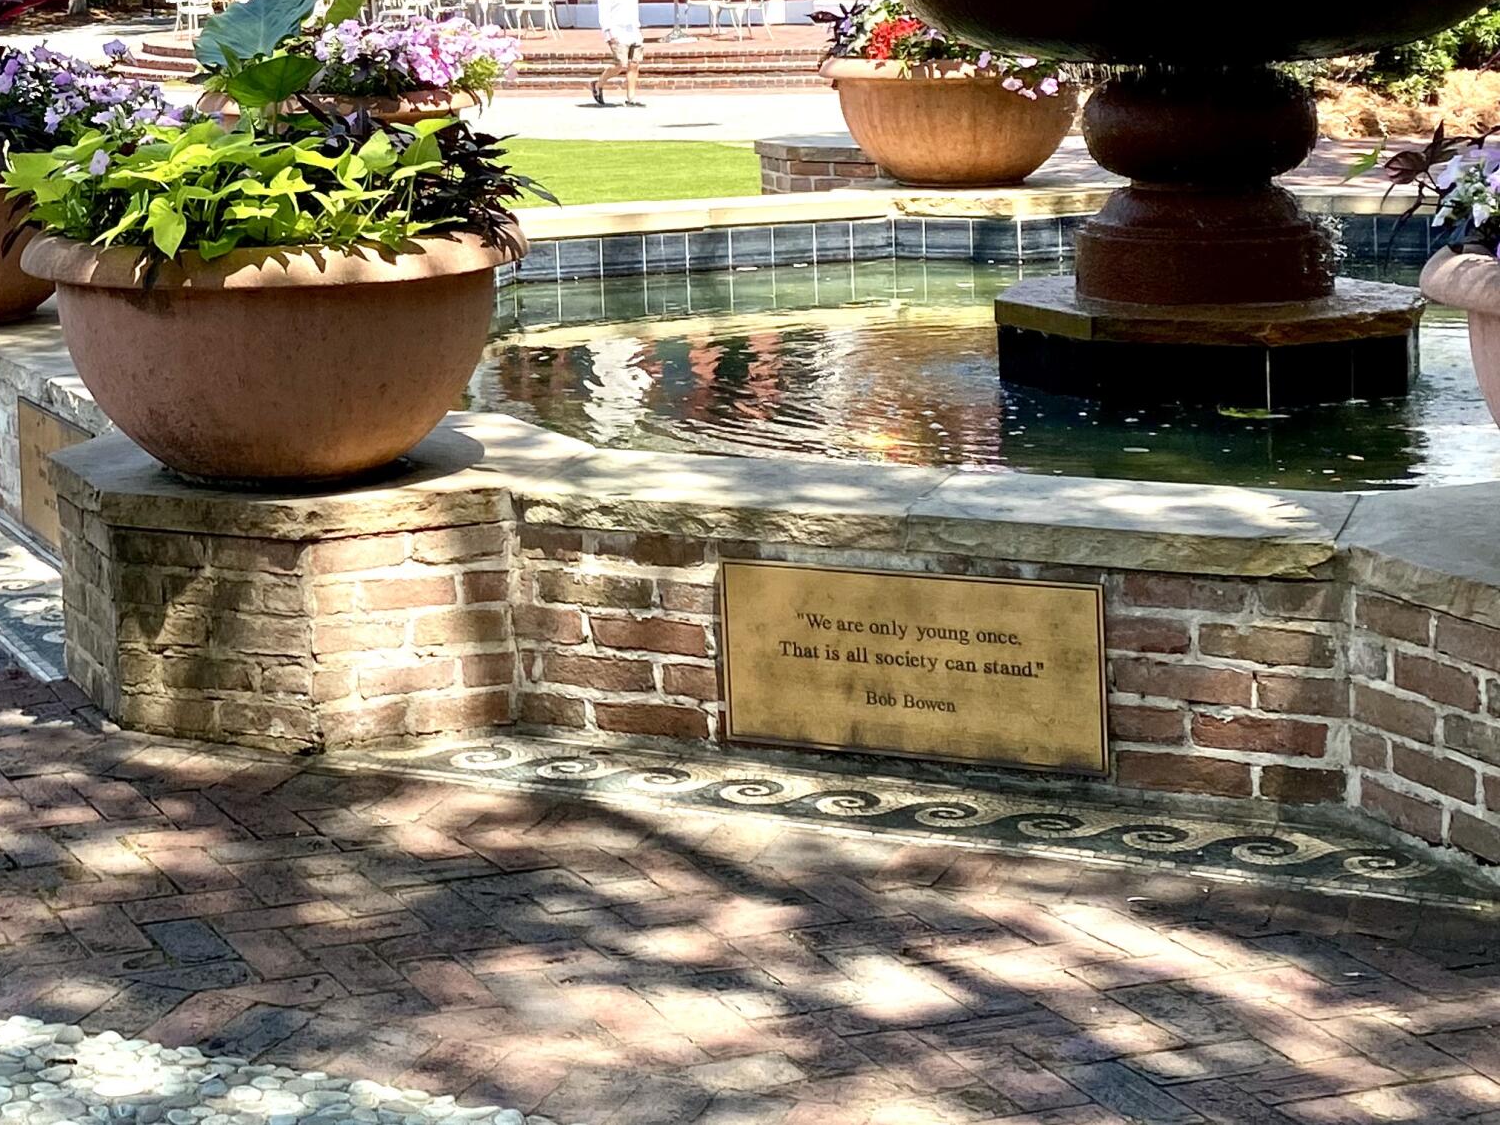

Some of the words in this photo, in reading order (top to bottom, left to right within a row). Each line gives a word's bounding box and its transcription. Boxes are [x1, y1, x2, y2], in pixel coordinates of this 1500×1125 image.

[797, 612, 832, 631] "We
[837, 620, 864, 635] are
[869, 619, 909, 640] only
[916, 626, 970, 646] young
[976, 628, 1022, 646] once.
[779, 640, 820, 660] That
[825, 644, 840, 661] is
[846, 644, 869, 664] all
[875, 650, 938, 672] society
[945, 657, 977, 673] can
[983, 659, 1045, 679] stand."
[865, 690, 897, 707] Bob
[903, 695, 957, 713] Bowen
